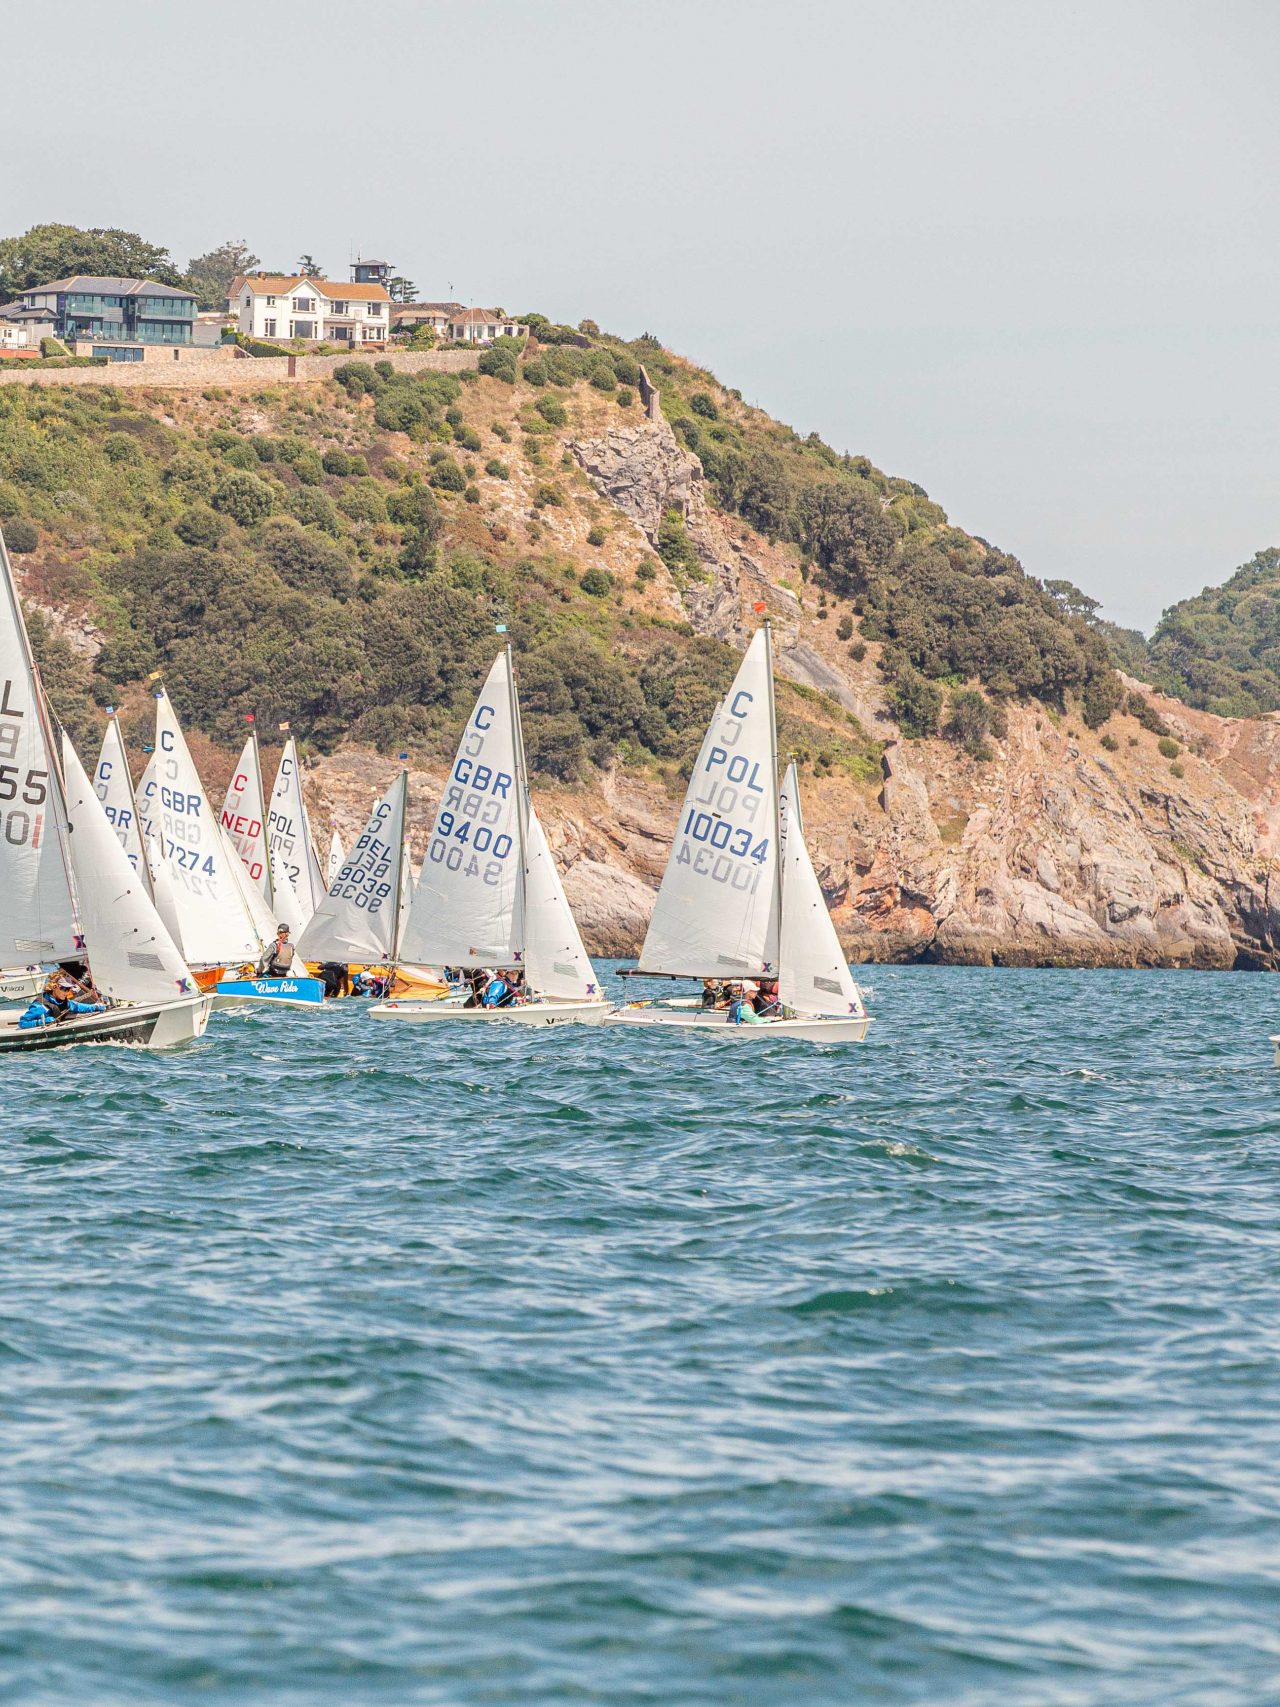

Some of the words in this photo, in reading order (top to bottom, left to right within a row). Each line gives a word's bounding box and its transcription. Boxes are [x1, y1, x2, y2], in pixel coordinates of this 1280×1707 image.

[474, 706, 495, 730] C
[731, 691, 754, 718] C
[161, 730, 174, 752] C
[100, 762, 112, 780] C
[281, 759, 292, 775] C
[454, 758, 512, 800] GBR
[705, 746, 764, 793] POL
[146, 782, 157, 796] C
[234, 774, 248, 792] C
[162, 786, 202, 817] GBR
[377, 804, 392, 818] C
[106, 806, 132, 829] BR
[221, 810, 262, 838] NED
[268, 810, 296, 838] POL
[356, 834, 392, 863] BEL
[438, 812, 512, 859] 9400
[684, 808, 770, 865] 10034
[166, 839, 216, 877] 7274
[338, 867, 392, 898] 9038
